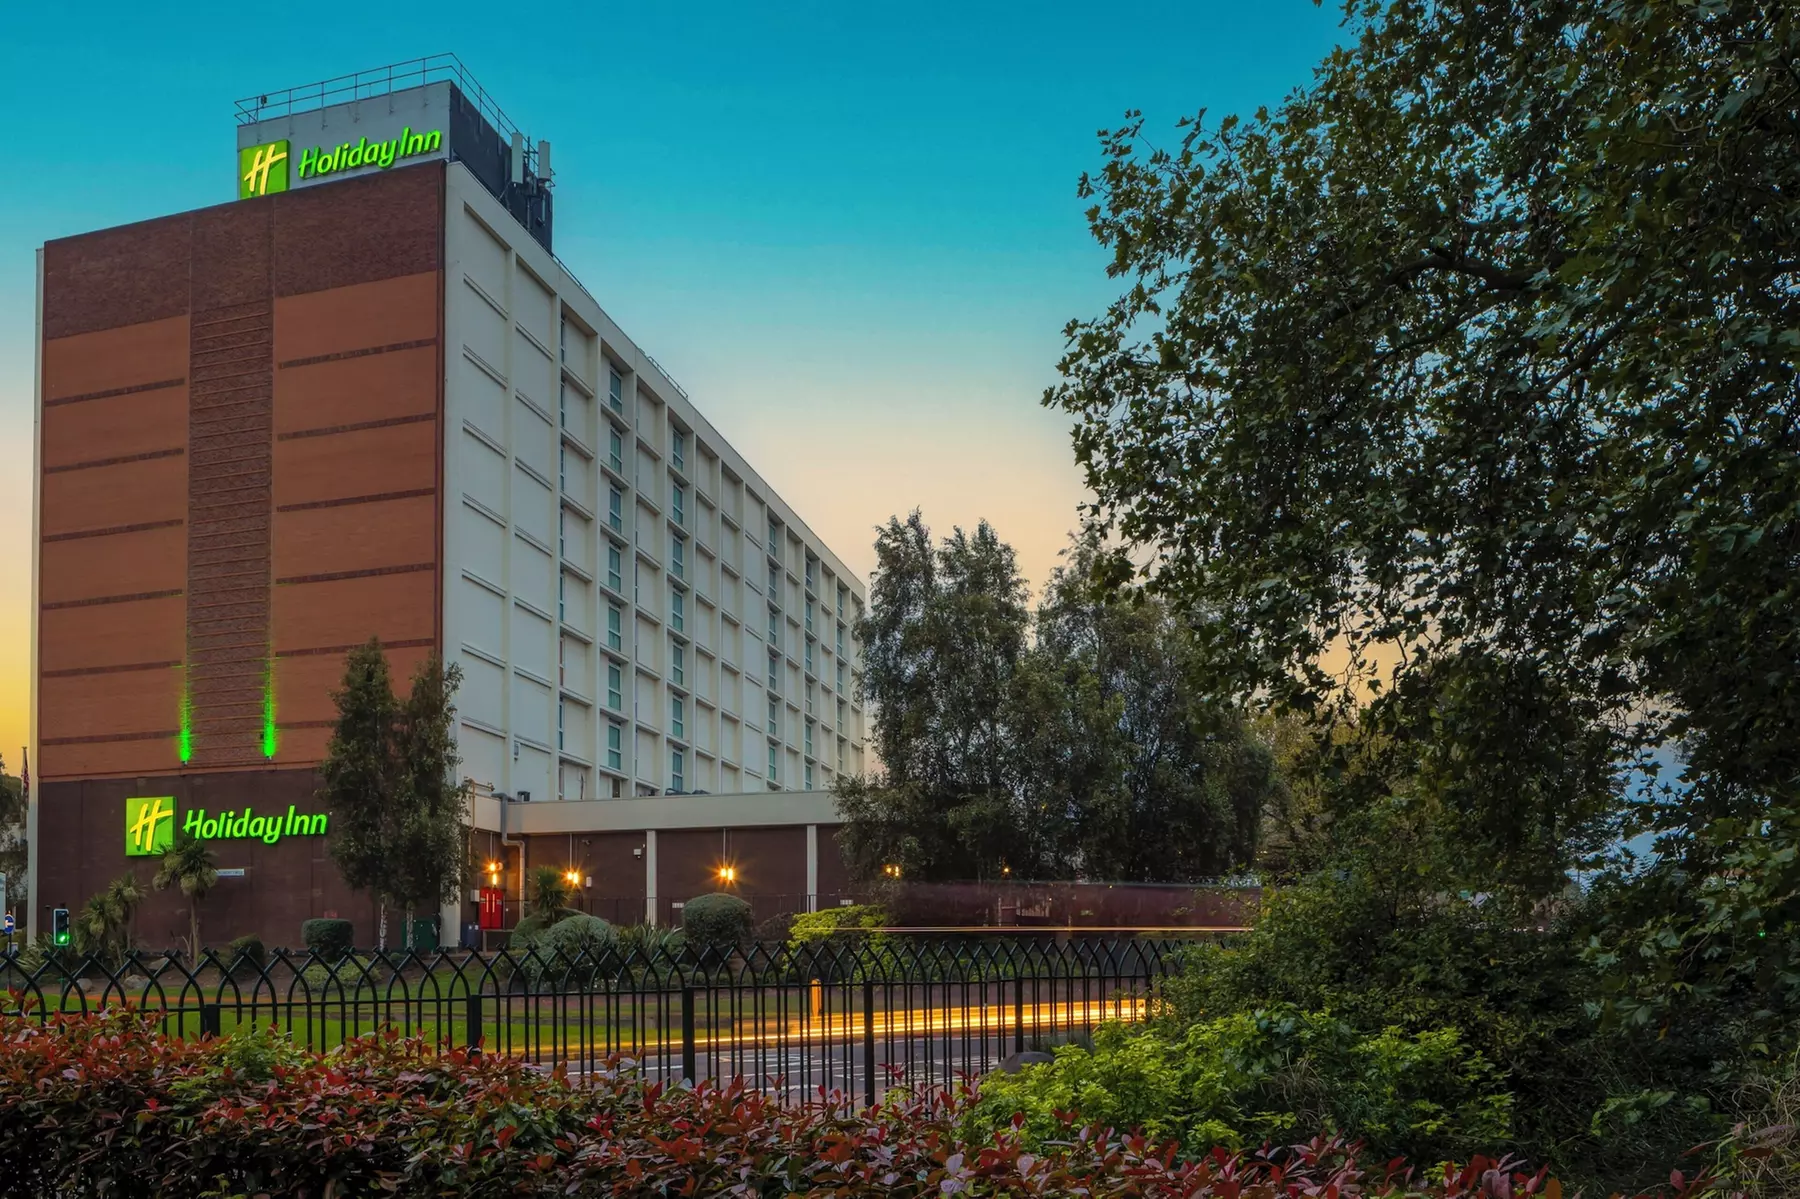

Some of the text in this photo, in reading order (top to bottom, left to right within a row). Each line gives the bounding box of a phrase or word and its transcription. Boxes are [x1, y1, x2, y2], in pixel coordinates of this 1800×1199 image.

[298, 127, 441, 178] Holiday Inn
[183, 805, 327, 844] Holiday Inn
